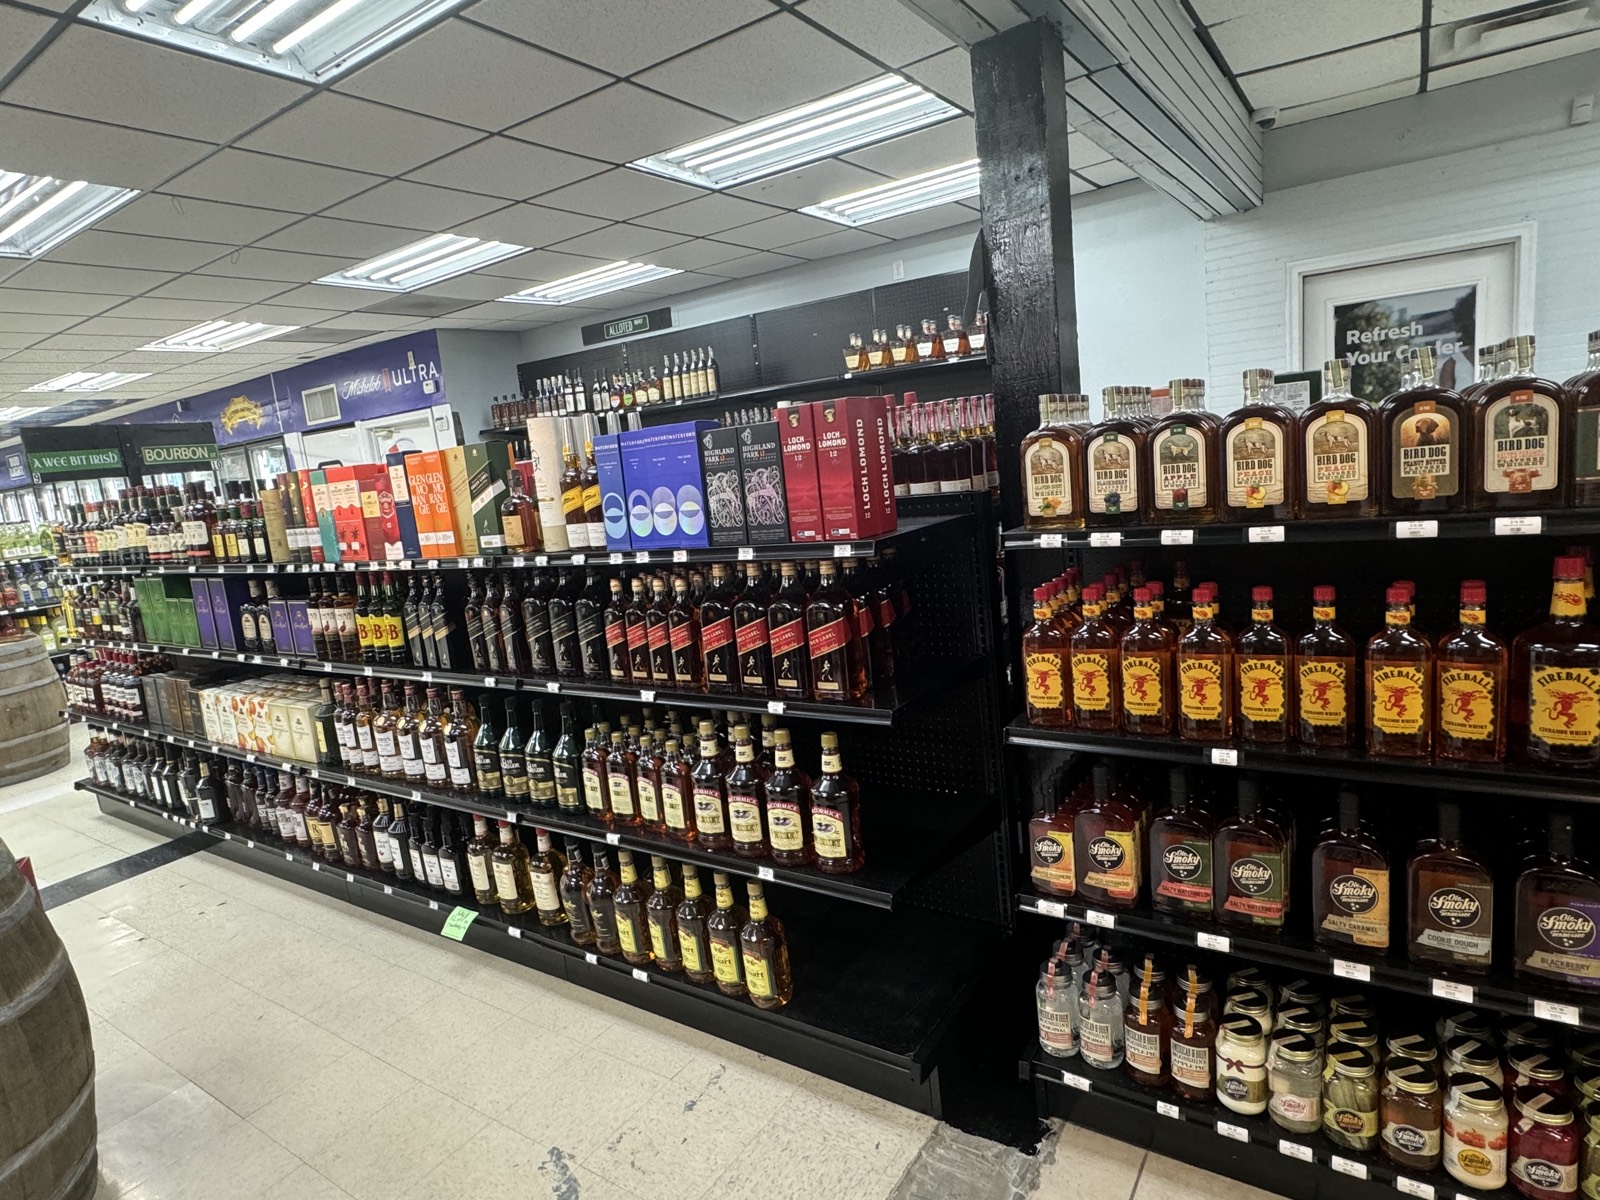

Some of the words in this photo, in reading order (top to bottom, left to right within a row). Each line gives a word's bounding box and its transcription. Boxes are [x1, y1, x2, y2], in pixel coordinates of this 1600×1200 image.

[609, 321, 633, 336] ALLOTED
[1346, 321, 1423, 345] Refresh
[1346, 350, 1391, 366] Your
[342, 374, 381, 399] Michelob
[392, 361, 440, 387] ULTRA
[788, 436, 804, 444] LOCH
[823, 431, 840, 440] LOCH
[742, 442, 775, 452] HIGHLAND
[784, 442, 810, 452] LOMOND
[818, 438, 846, 448] LOMOND
[856, 418, 867, 474] LOMOND
[877, 418, 887, 471] LOMOND
[1498, 440, 1522, 451] BIRD
[1525, 438, 1545, 449] DOG
[145, 446, 208, 461] BOURBON
[704, 447, 734, 456] HIGHLAND
[1404, 448, 1426, 459] BIRD
[1429, 446, 1446, 457] DOG
[33, 459, 42, 468] A
[43, 456, 68, 468] WEE
[72, 455, 88, 466] BIT
[90, 452, 118, 464] IRISH
[1237, 460, 1255, 471] BIRD
[1257, 459, 1272, 469] DOG
[1317, 455, 1337, 465] BIRD
[1339, 453, 1355, 463] DOG
[1096, 471, 1112, 480] BIRD
[1114, 470, 1127, 479] DOG
[1163, 465, 1180, 474] BIRD
[1182, 464, 1196, 473] DOG
[33, 473, 40, 483] 9
[426, 472, 443, 483] GLEN
[1034, 476, 1049, 484] BIRD
[1050, 475, 1062, 483] DOG
[416, 484, 428, 494] MO
[433, 482, 445, 492] MO
[882, 474, 890, 504] LOCH
[413, 494, 426, 505] RAN
[429, 493, 443, 504] RAN
[862, 477, 870, 510] LOCH
[711, 629, 724, 638] LABEL
[746, 630, 760, 639] LABEL
[780, 631, 795, 641] LABEL
[820, 632, 836, 642] LABEL
[1027, 656, 1059, 668] FIREBALL
[1073, 657, 1105, 668] FIREBALL
[1124, 660, 1158, 674] FIREBALL
[1182, 663, 1219, 676] FIREBALL
[1242, 663, 1281, 676] FIREBALL
[1301, 665, 1343, 679] FIREBALL
[1375, 670, 1421, 685] FIREBALL
[1443, 673, 1492, 689] FIREBALL
[1537, 672, 1596, 690] FIREBALL
[1036, 842, 1062, 853] Smoky
[1090, 844, 1122, 856] Smoky
[1165, 852, 1200, 866] Smoky
[1232, 866, 1271, 880] Smoky
[1162, 885, 1176, 894] SALTY
[1332, 882, 1375, 898] Smoky
[1230, 900, 1246, 909] SALTY
[1431, 896, 1478, 912] Smoky
[1540, 915, 1593, 933] Smoky
[1560, 914, 1574, 922] Ole
[1328, 918, 1347, 927] SALTY
[1348, 923, 1378, 933] CARAMEL
[1427, 934, 1452, 944] COOKIE
[1454, 939, 1478, 948] DOUGH
[1541, 957, 1590, 971] BLACKBERRY
